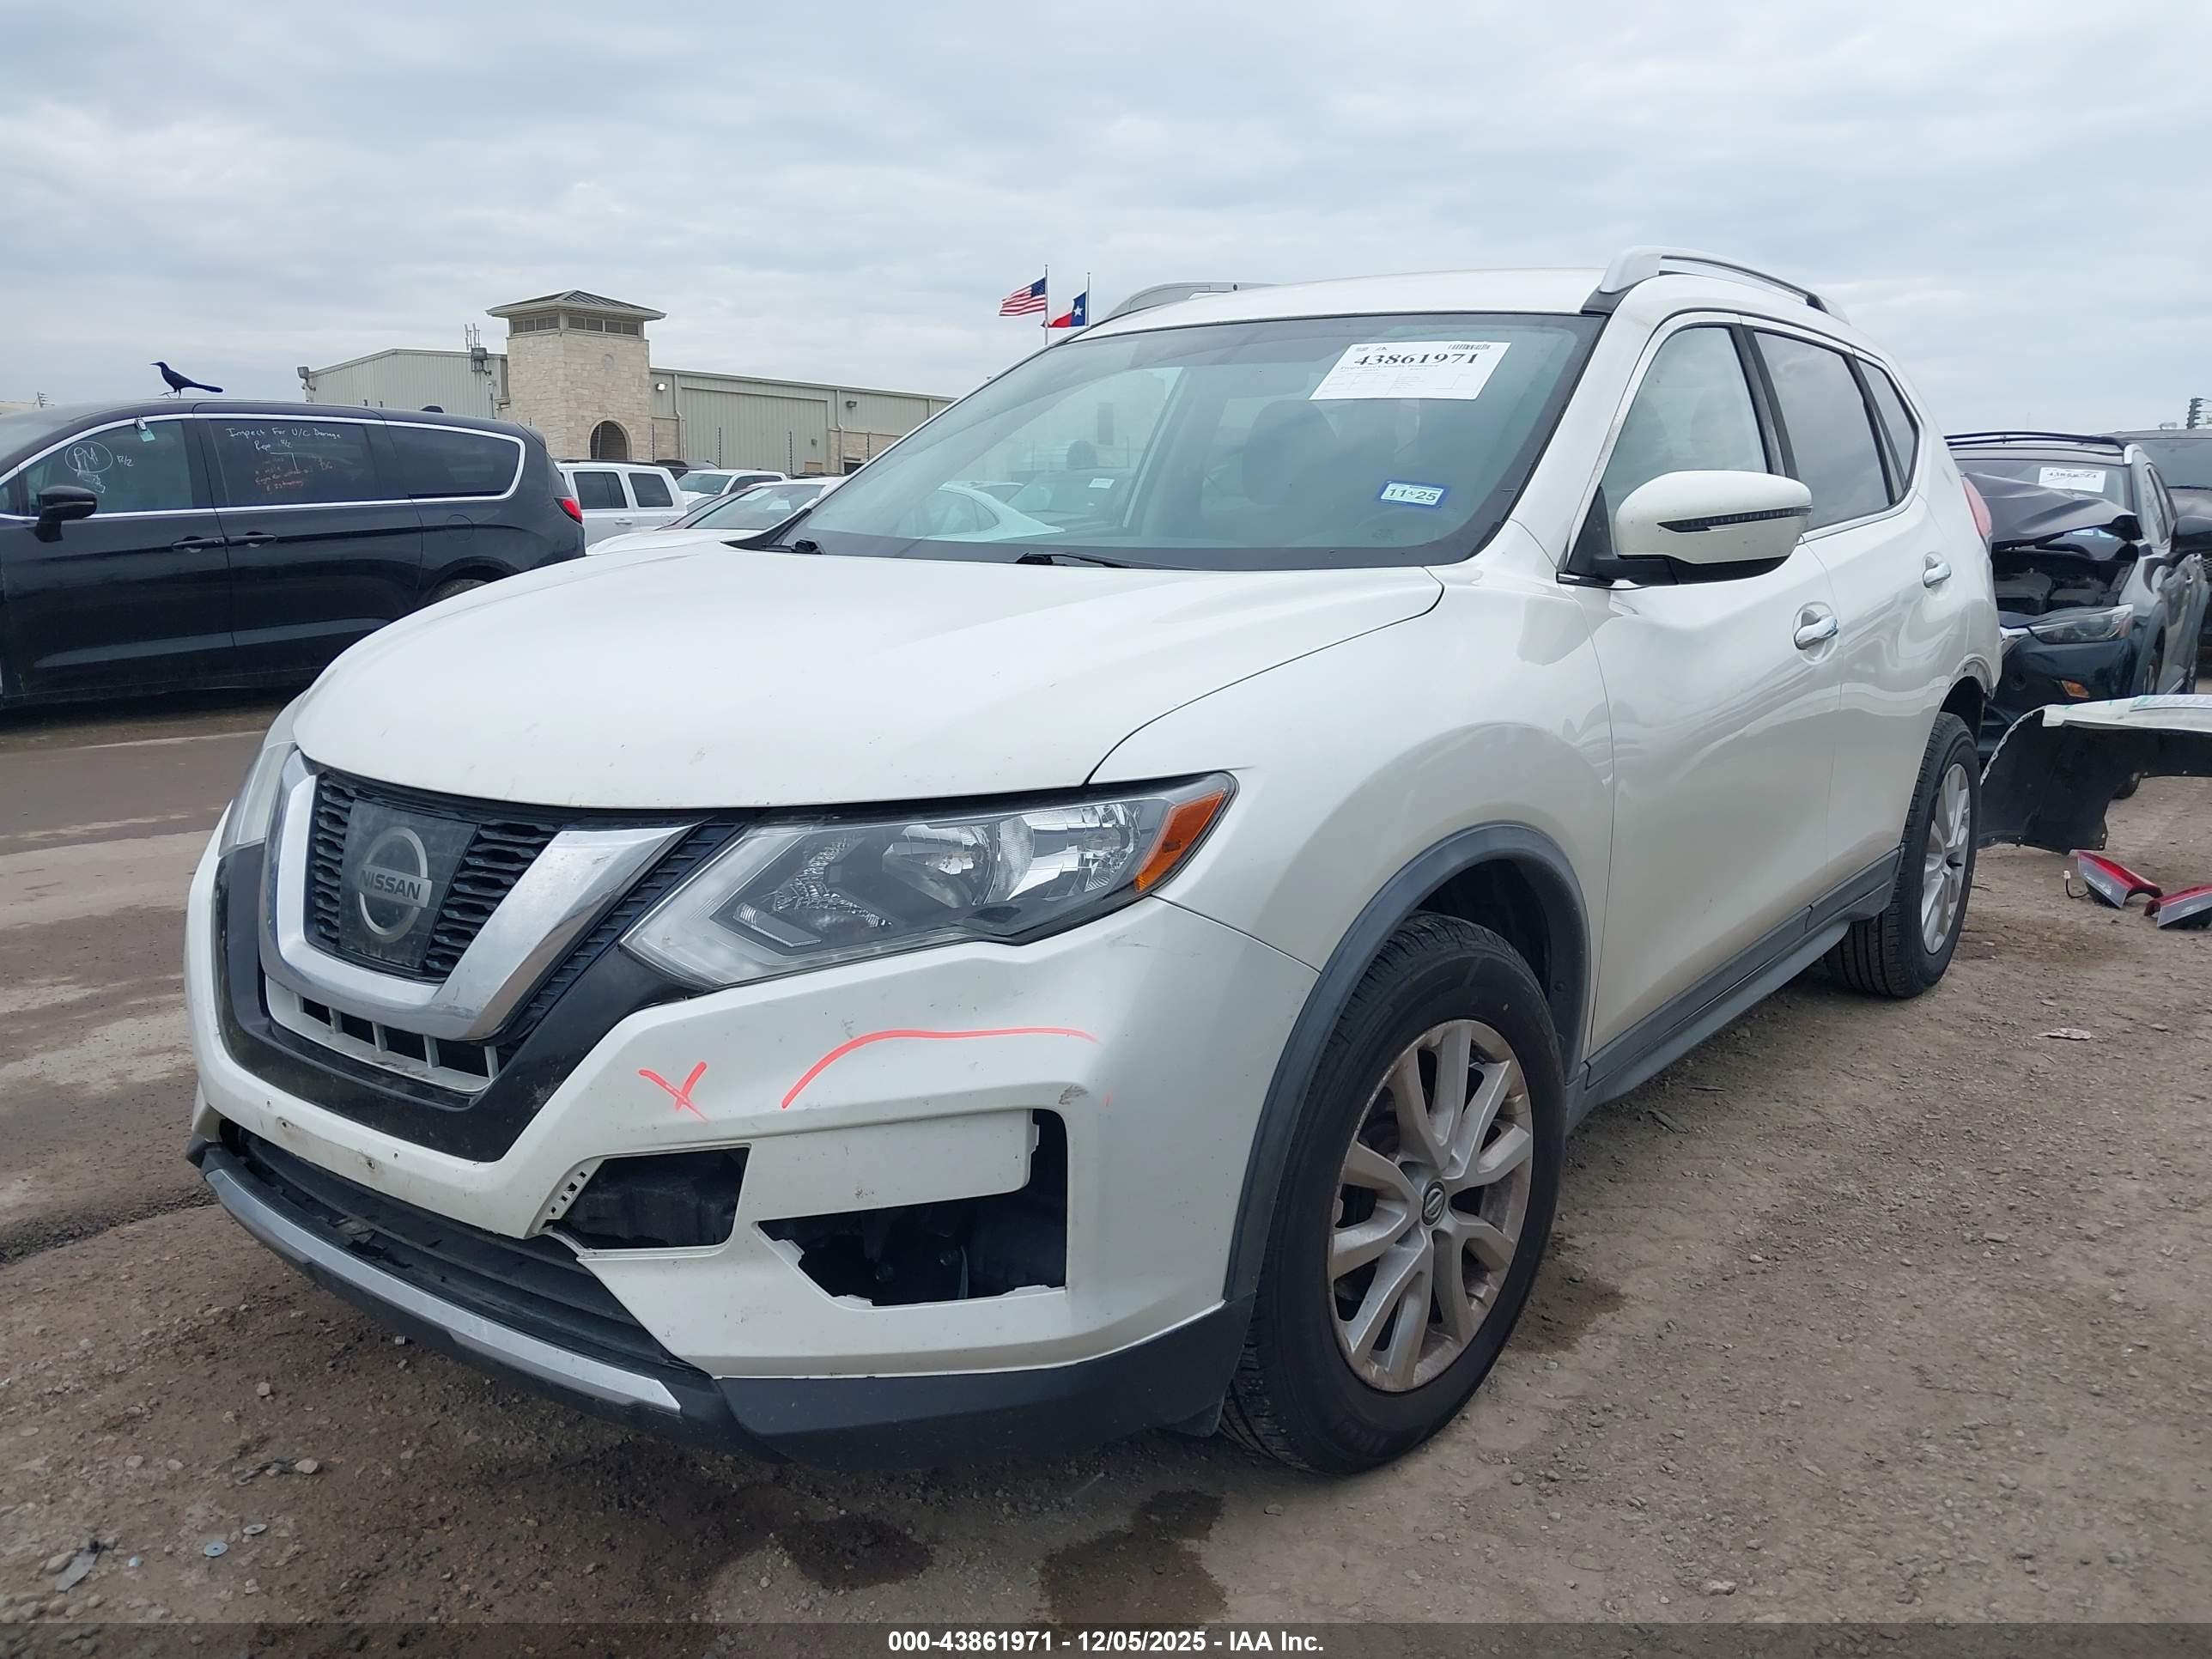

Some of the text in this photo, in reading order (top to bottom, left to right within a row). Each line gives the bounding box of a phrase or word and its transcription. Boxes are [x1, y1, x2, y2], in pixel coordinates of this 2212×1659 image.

[1353, 352, 1479, 366] 43861971
[1414, 490, 1437, 501] 25
[360, 869, 421, 901] NISSAN
